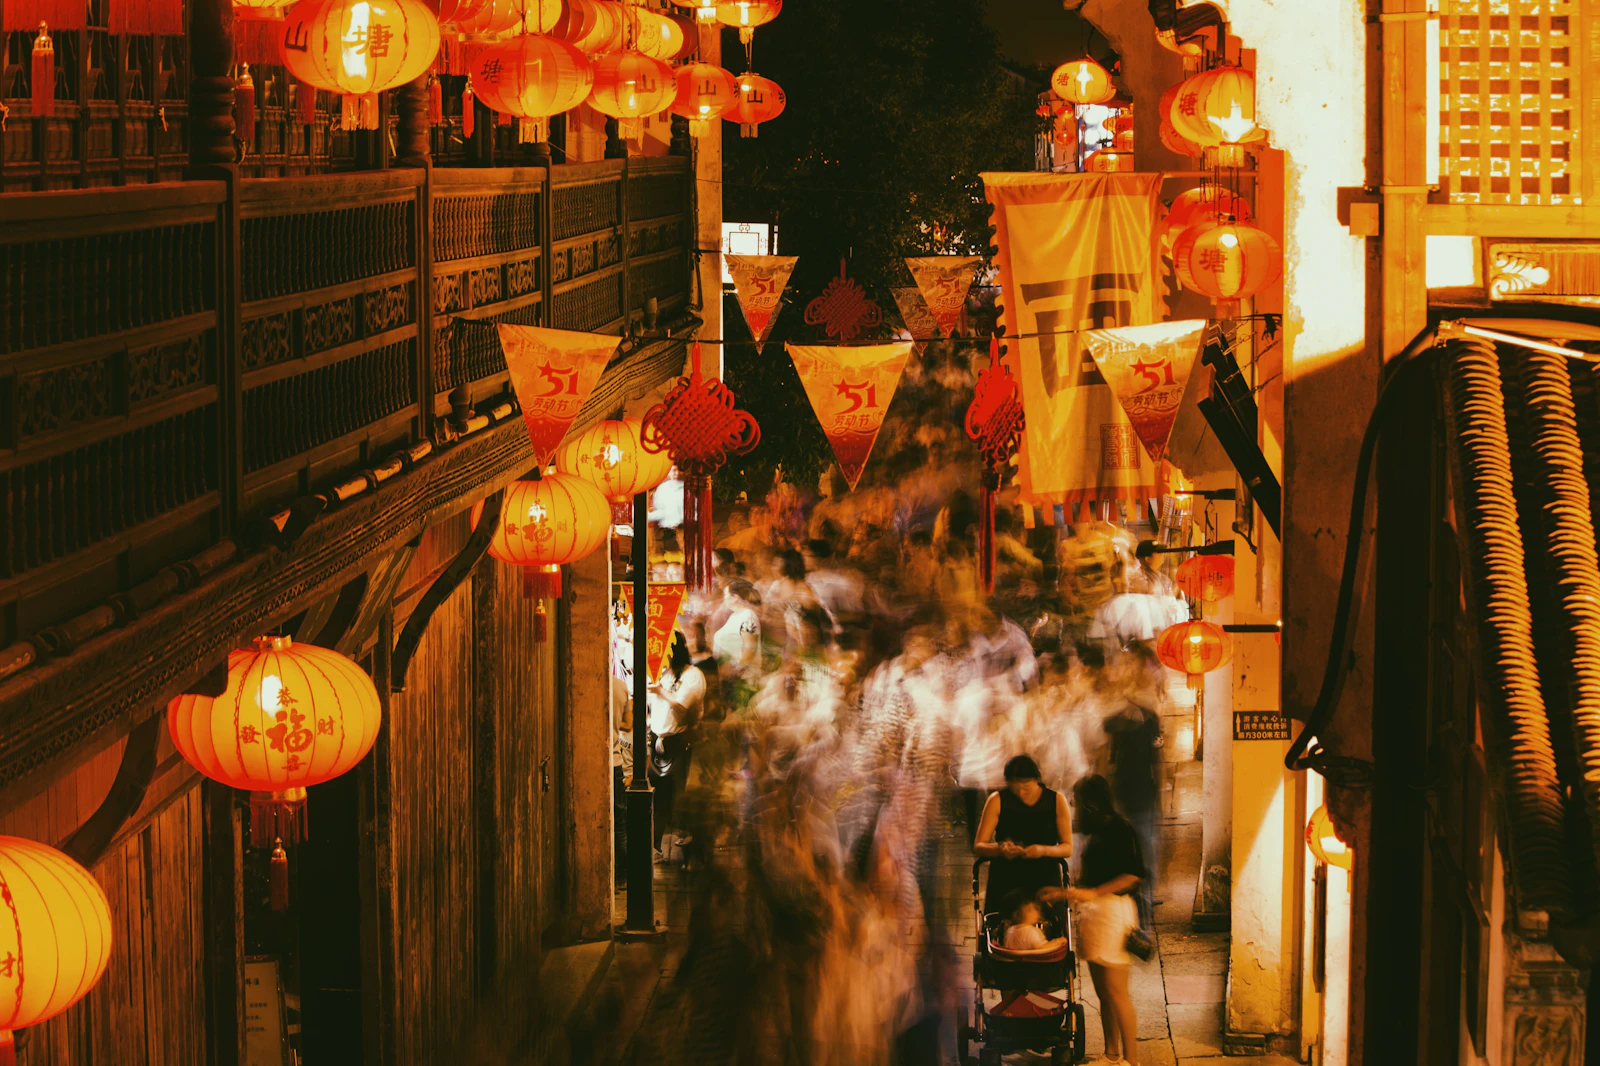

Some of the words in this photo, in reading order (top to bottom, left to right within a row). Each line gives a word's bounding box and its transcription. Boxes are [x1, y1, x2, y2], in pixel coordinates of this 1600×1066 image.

[284, 20, 308, 52] 山
[342, 23, 394, 58] 塘
[480, 58, 505, 85] 塘
[635, 74, 657, 94] 山
[697, 79, 717, 97] 山
[746, 89, 764, 104] 山
[1198, 248, 1228, 274] 塘
[749, 273, 777, 297] 51
[934, 275, 961, 298] 51
[533, 359, 581, 398] 51
[1128, 355, 1178, 396] 51
[532, 397, 570, 413] 劳动节
[832, 377, 881, 416] 51
[1133, 391, 1170, 407] 劳动节
[833, 414, 871, 428] 劳动节
[276, 686, 299, 707] 恭
[239, 724, 262, 745] 發
[265, 708, 314, 753] 福
[317, 715, 336, 736] 財
